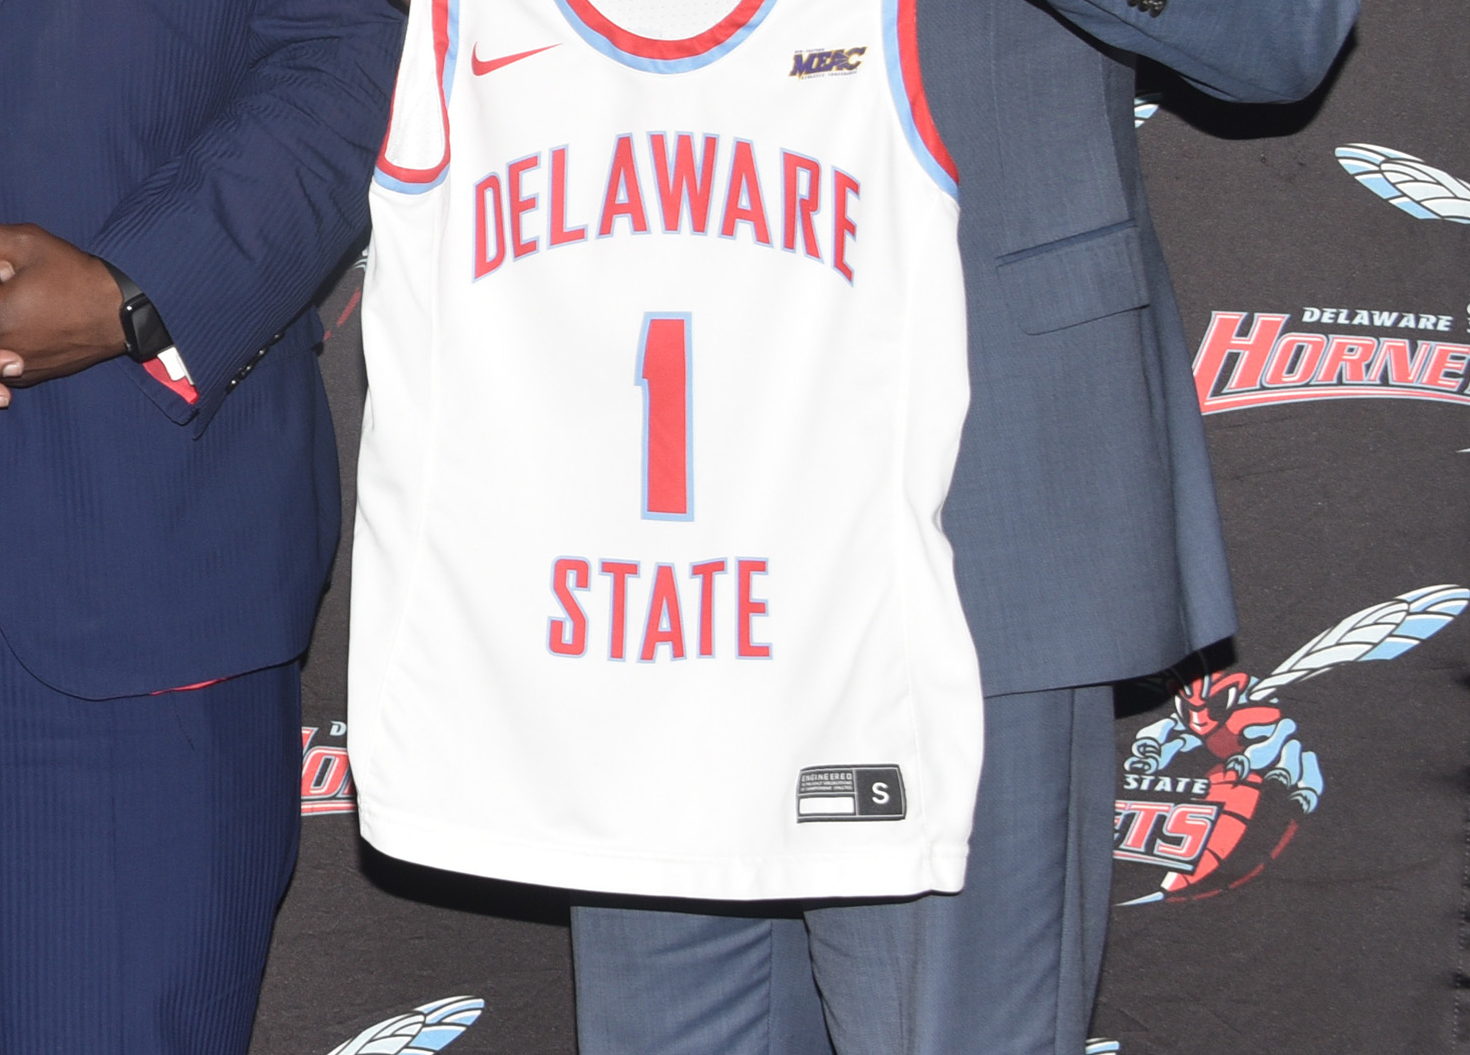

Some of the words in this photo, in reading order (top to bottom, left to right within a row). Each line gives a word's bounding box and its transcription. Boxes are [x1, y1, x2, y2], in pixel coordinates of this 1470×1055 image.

[788, 46, 868, 79] MEAC
[473, 130, 860, 287] DELAWARE
[1302, 307, 1454, 332] DELAWARE
[634, 311, 694, 522] 1
[546, 556, 773, 664] STATE
[872, 782, 890, 804] S
[1123, 774, 1209, 794] STATE
